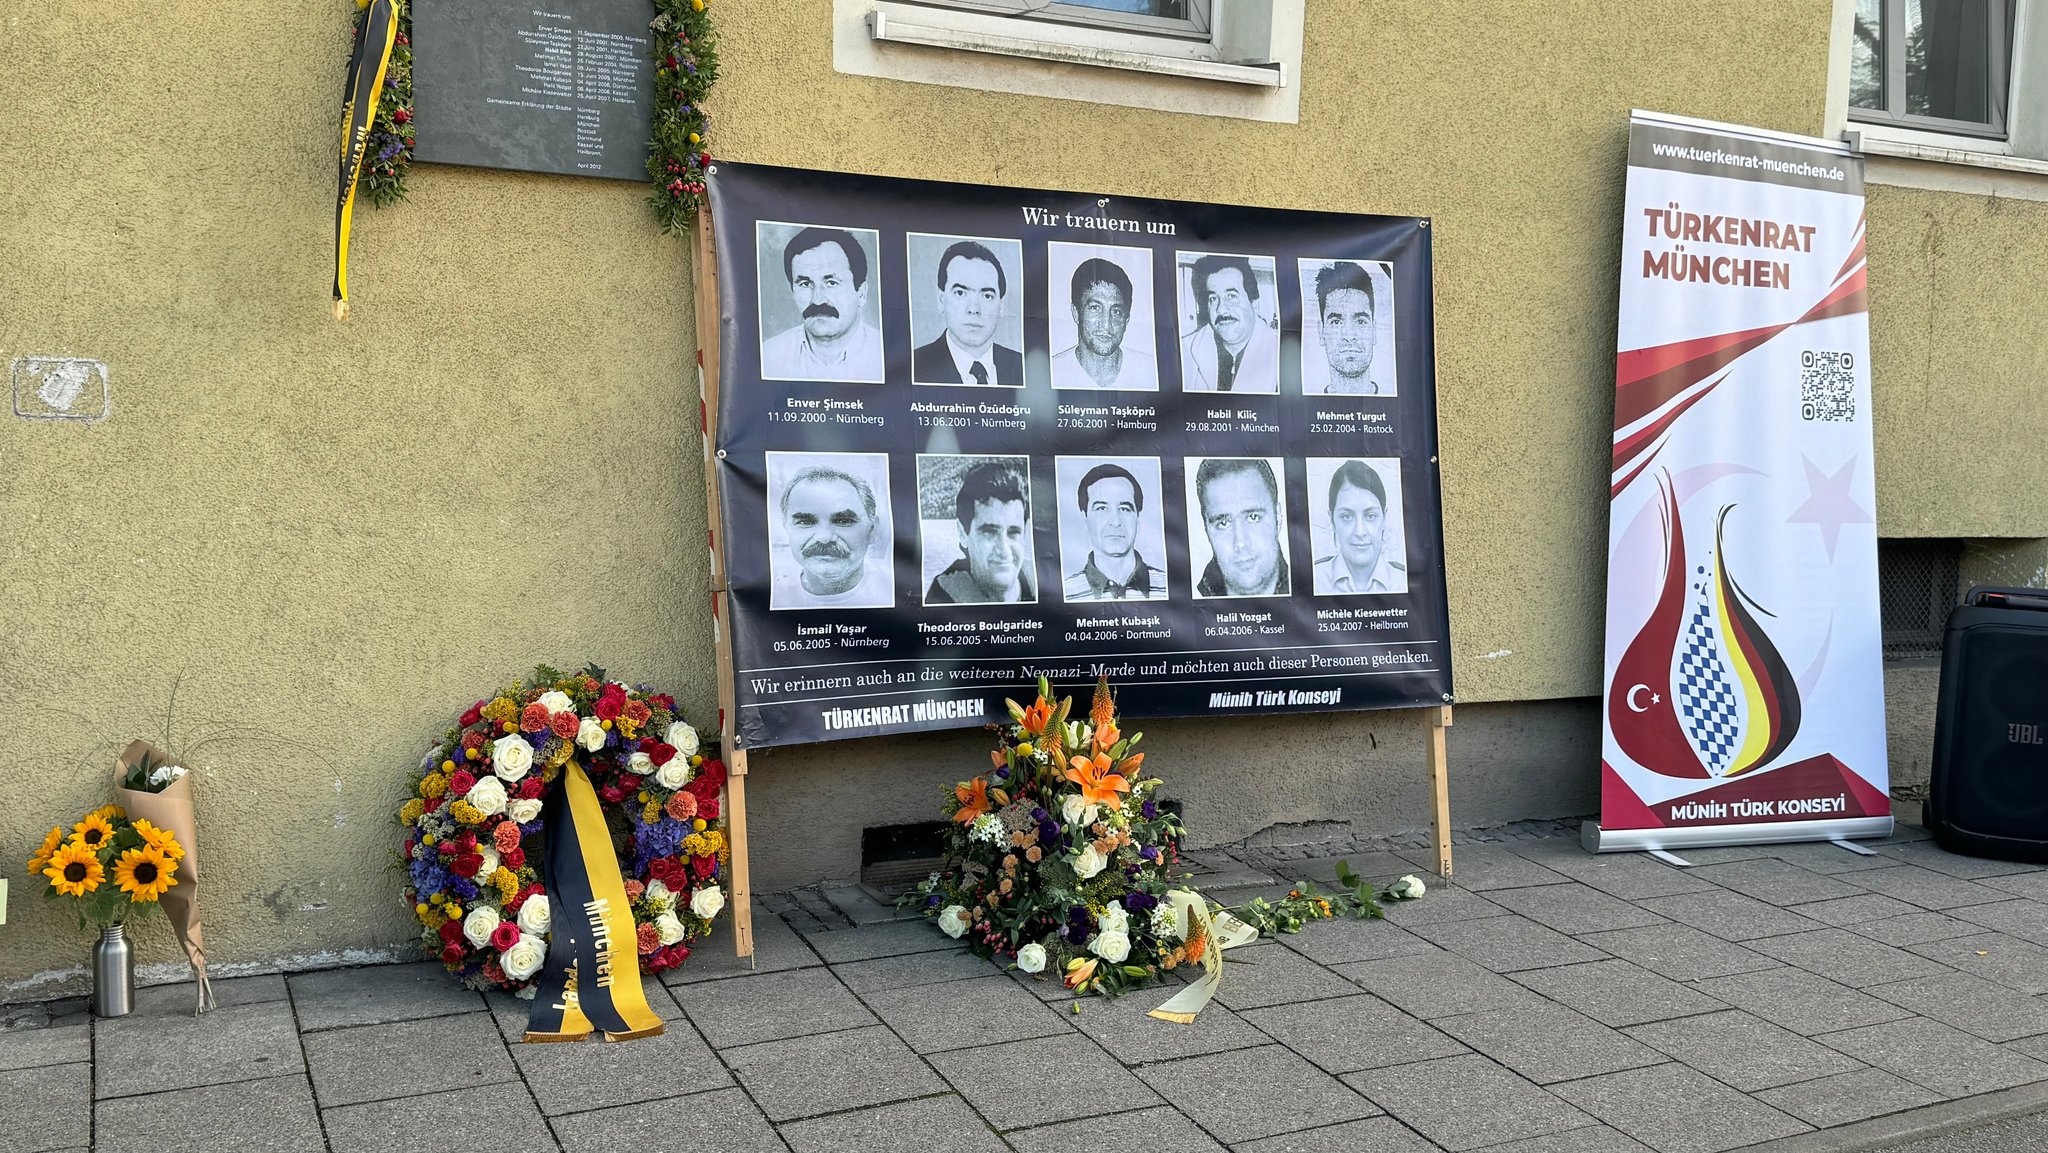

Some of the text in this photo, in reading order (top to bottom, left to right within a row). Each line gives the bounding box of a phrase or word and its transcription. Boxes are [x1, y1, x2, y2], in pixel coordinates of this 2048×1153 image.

[486, 97, 520, 106] Gemeinsame
[521, 101, 545, 109] Erklärung
[1653, 142, 1844, 181] www.tuerkenrat-muenchen.de
[1022, 206, 1176, 236] Wir trauern um
[1644, 202, 1816, 253] TÜRKENRAT
[1642, 244, 1790, 290] MÜNCHEN
[787, 398, 820, 408] Enver
[910, 402, 1031, 416] Abdurrahim Özüdoğru
[1058, 405, 1155, 418] Süleyman Taşköprü
[1207, 410, 1232, 419] Habil
[1317, 412, 1386, 422] Mehmet Turgut
[768, 412, 826, 422] 11.09.2000
[836, 414, 884, 426] Nürnberg
[918, 416, 971, 427] 13.06.2001
[982, 418, 1026, 430] Nürnberg
[1058, 419, 1107, 428] 27.06.2001
[1117, 420, 1157, 431] Hamburg
[1186, 422, 1232, 432] 29.08.2001
[1241, 423, 1280, 432] München
[1310, 424, 1356, 433] 25.02.2004
[1364, 425, 1394, 434] Rostock
[1216, 612, 1272, 623] Halil Yozgat
[1317, 608, 1408, 619] Michèle Kiesewetter
[798, 623, 867, 636] İsmail Yaşar
[918, 620, 1043, 632] Theodoros Boulgarides
[1076, 618, 1119, 628] Mehmet
[1318, 622, 1363, 632] 25.04.2007
[1370, 620, 1409, 630] Heilbronn
[1065, 630, 1118, 641] 04.04.2006
[1126, 628, 1171, 640] Dortmund
[1205, 626, 1253, 636] 06.04.2006
[1260, 624, 1285, 634] Kassel
[773, 639, 831, 652] 05.06.2005
[841, 637, 890, 648] Nürnberg
[926, 635, 980, 646] 15.06.2005
[990, 634, 1035, 644] München
[751, 678, 780, 695] Wir
[784, 676, 851, 692] erinnern
[856, 669, 892, 686] auch
[897, 672, 916, 683] an
[920, 667, 944, 681] die
[949, 666, 1015, 679] weiteren
[1140, 661, 1167, 675] und
[1171, 659, 1229, 674] möchten
[1233, 657, 1265, 671] auch
[1269, 656, 1307, 670] dieser
[1310, 654, 1369, 668] Personen
[1371, 650, 1433, 667] gedenken.
[1208, 688, 1342, 708] Münih Türk Konseyi
[822, 698, 984, 730] TÜRKENRAT MÜNCHEN
[2008, 723, 2044, 744] JBL
[1671, 793, 1846, 820] MÜNİH TÜRK KONSEYİ
[583, 898, 619, 988] München
